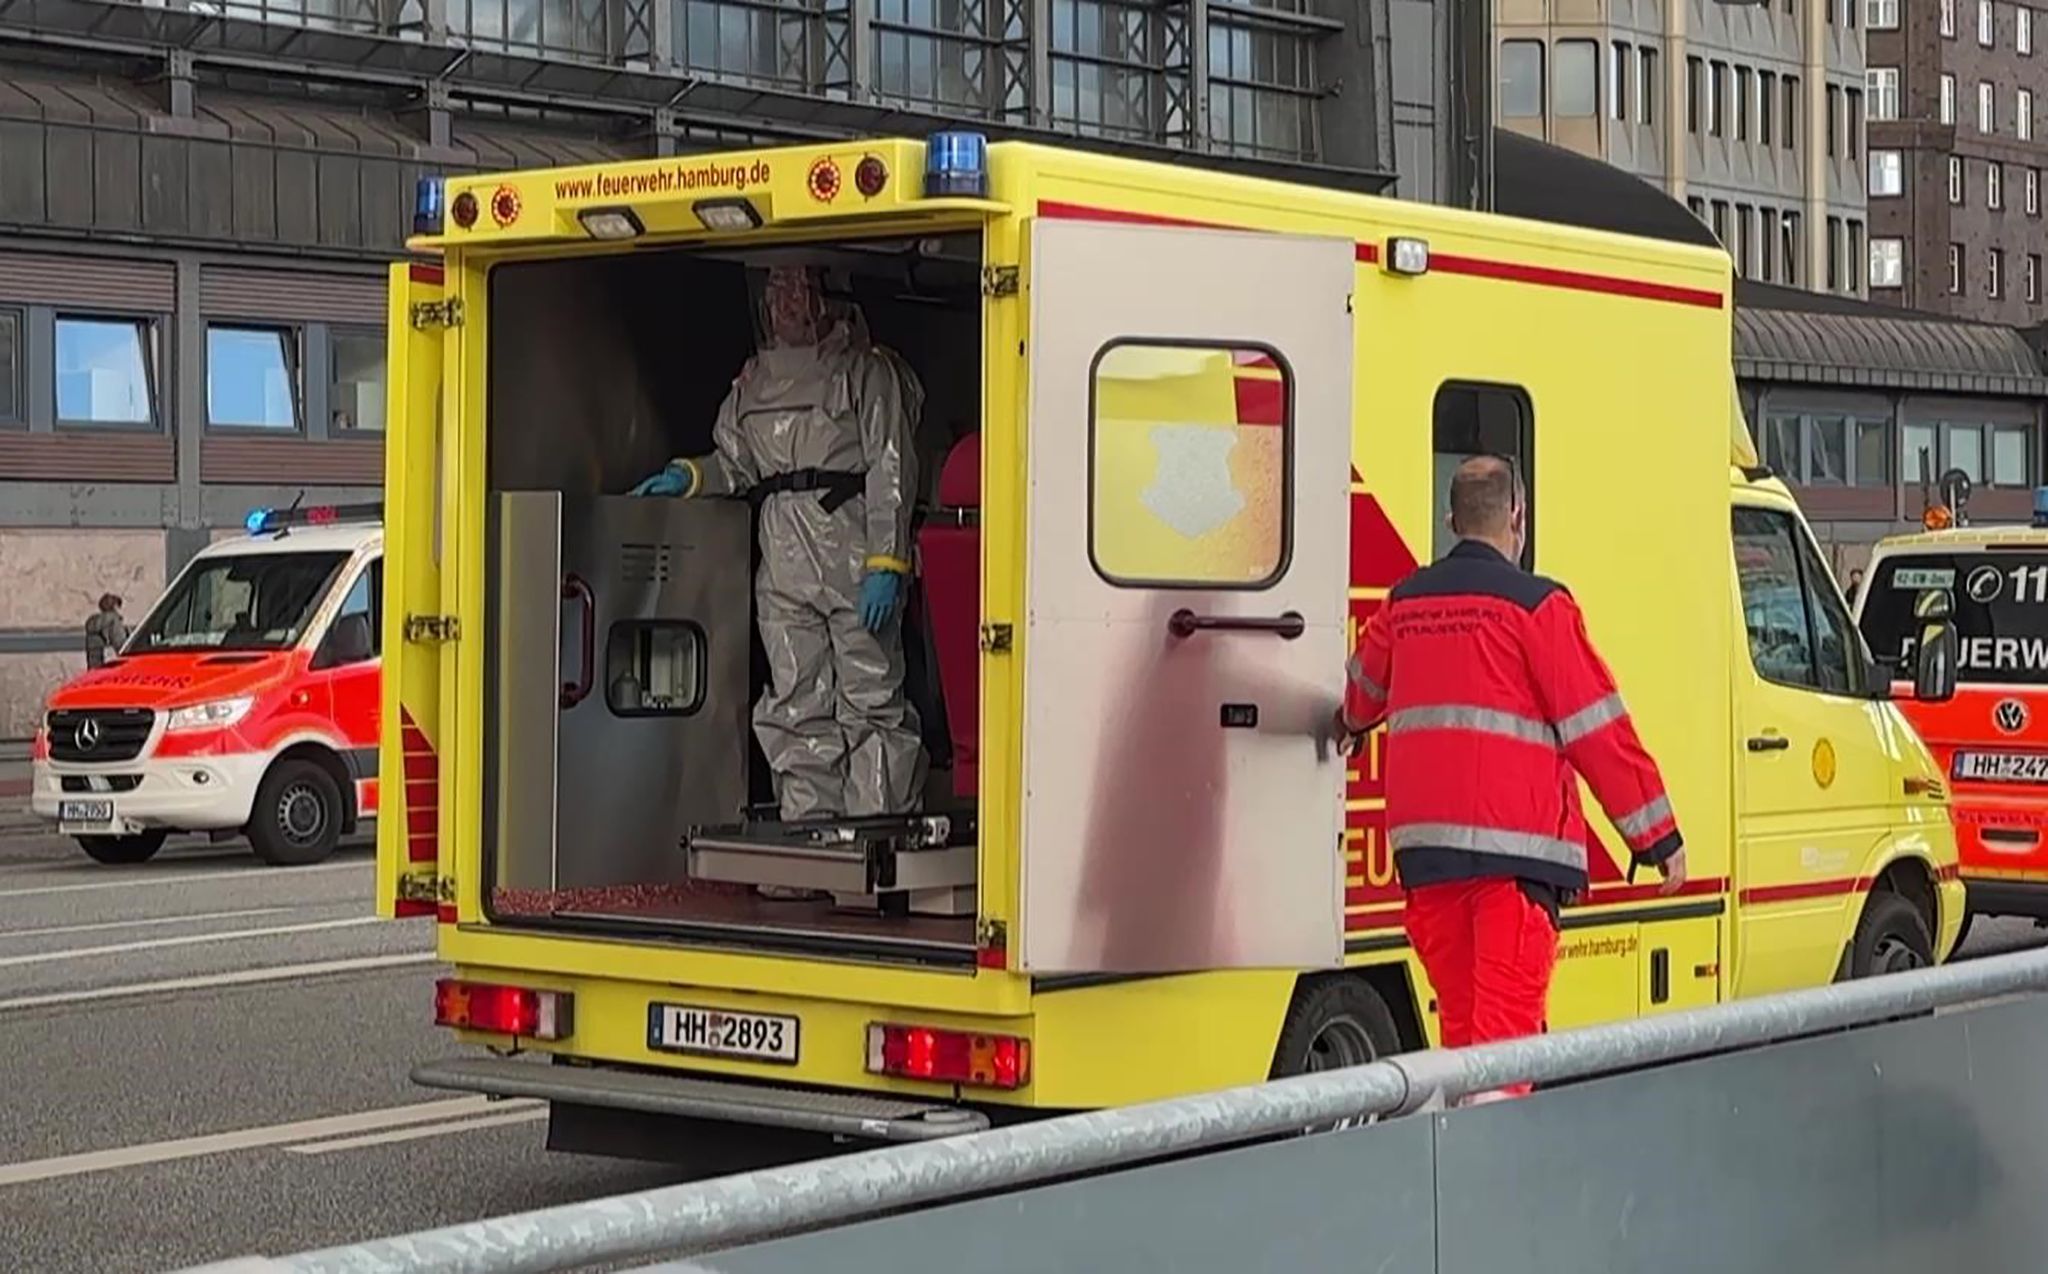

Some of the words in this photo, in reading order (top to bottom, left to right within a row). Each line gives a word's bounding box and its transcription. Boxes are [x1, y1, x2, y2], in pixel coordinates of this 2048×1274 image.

[555, 160, 769, 199] www.feuerwehr.hamburg.de
[2008, 566, 2048, 602] 11
[1974, 755, 2000, 775] HH
[675, 1011, 707, 1044] HH
[723, 1016, 783, 1052] 2893
